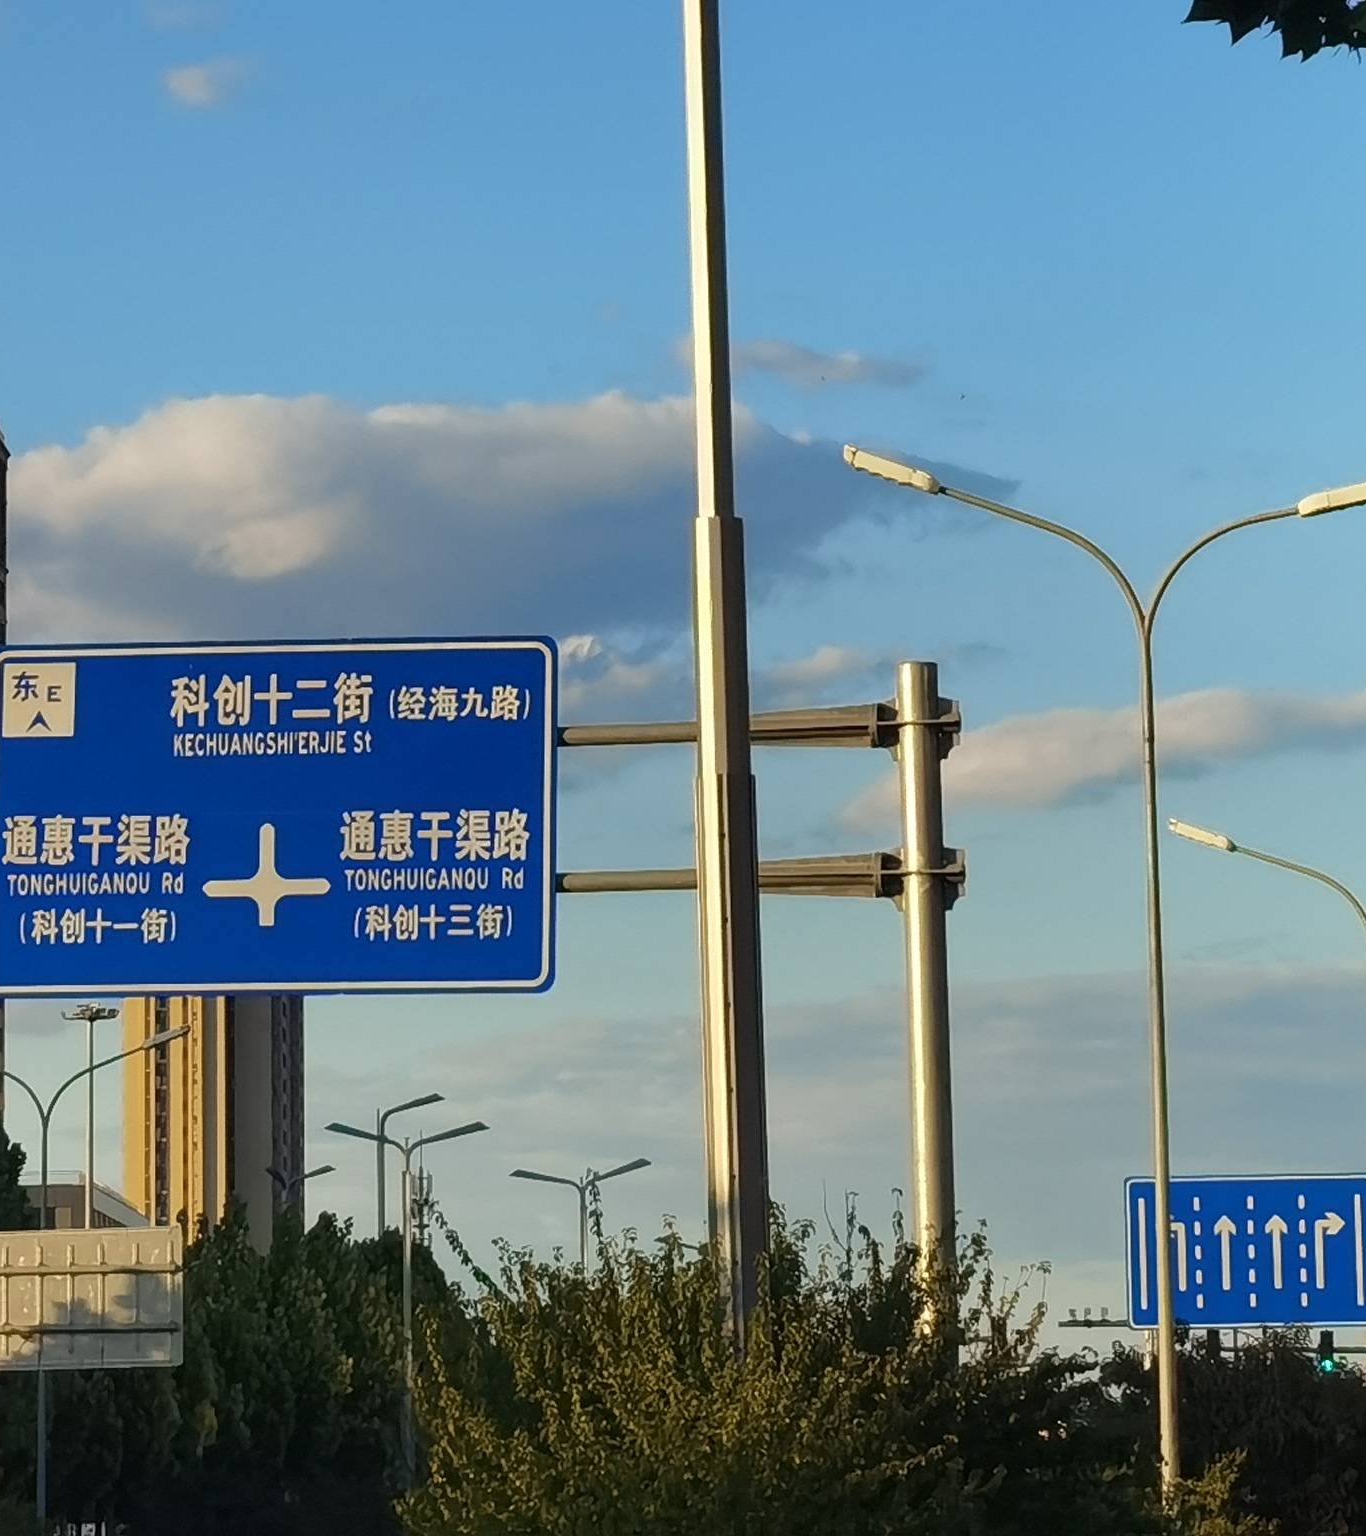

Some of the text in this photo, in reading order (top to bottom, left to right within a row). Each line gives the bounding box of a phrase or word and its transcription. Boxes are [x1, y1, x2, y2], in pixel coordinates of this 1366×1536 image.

[11, 671, 62, 702] 东 E
[170, 672, 531, 728] 科创十二街 (经海九路)
[173, 728, 372, 757] KECHUANGSHI'ERJIE St
[1, 814, 191, 866] 通惠干渠路
[340, 807, 530, 862] 通惠干渠路
[7, 872, 184, 896] TONGHUIGANQU Rd
[344, 867, 524, 891] TONGHUIGANQU Rd
[20, 908, 176, 945] (科创十一街)
[354, 903, 513, 942] (科创十三街)
